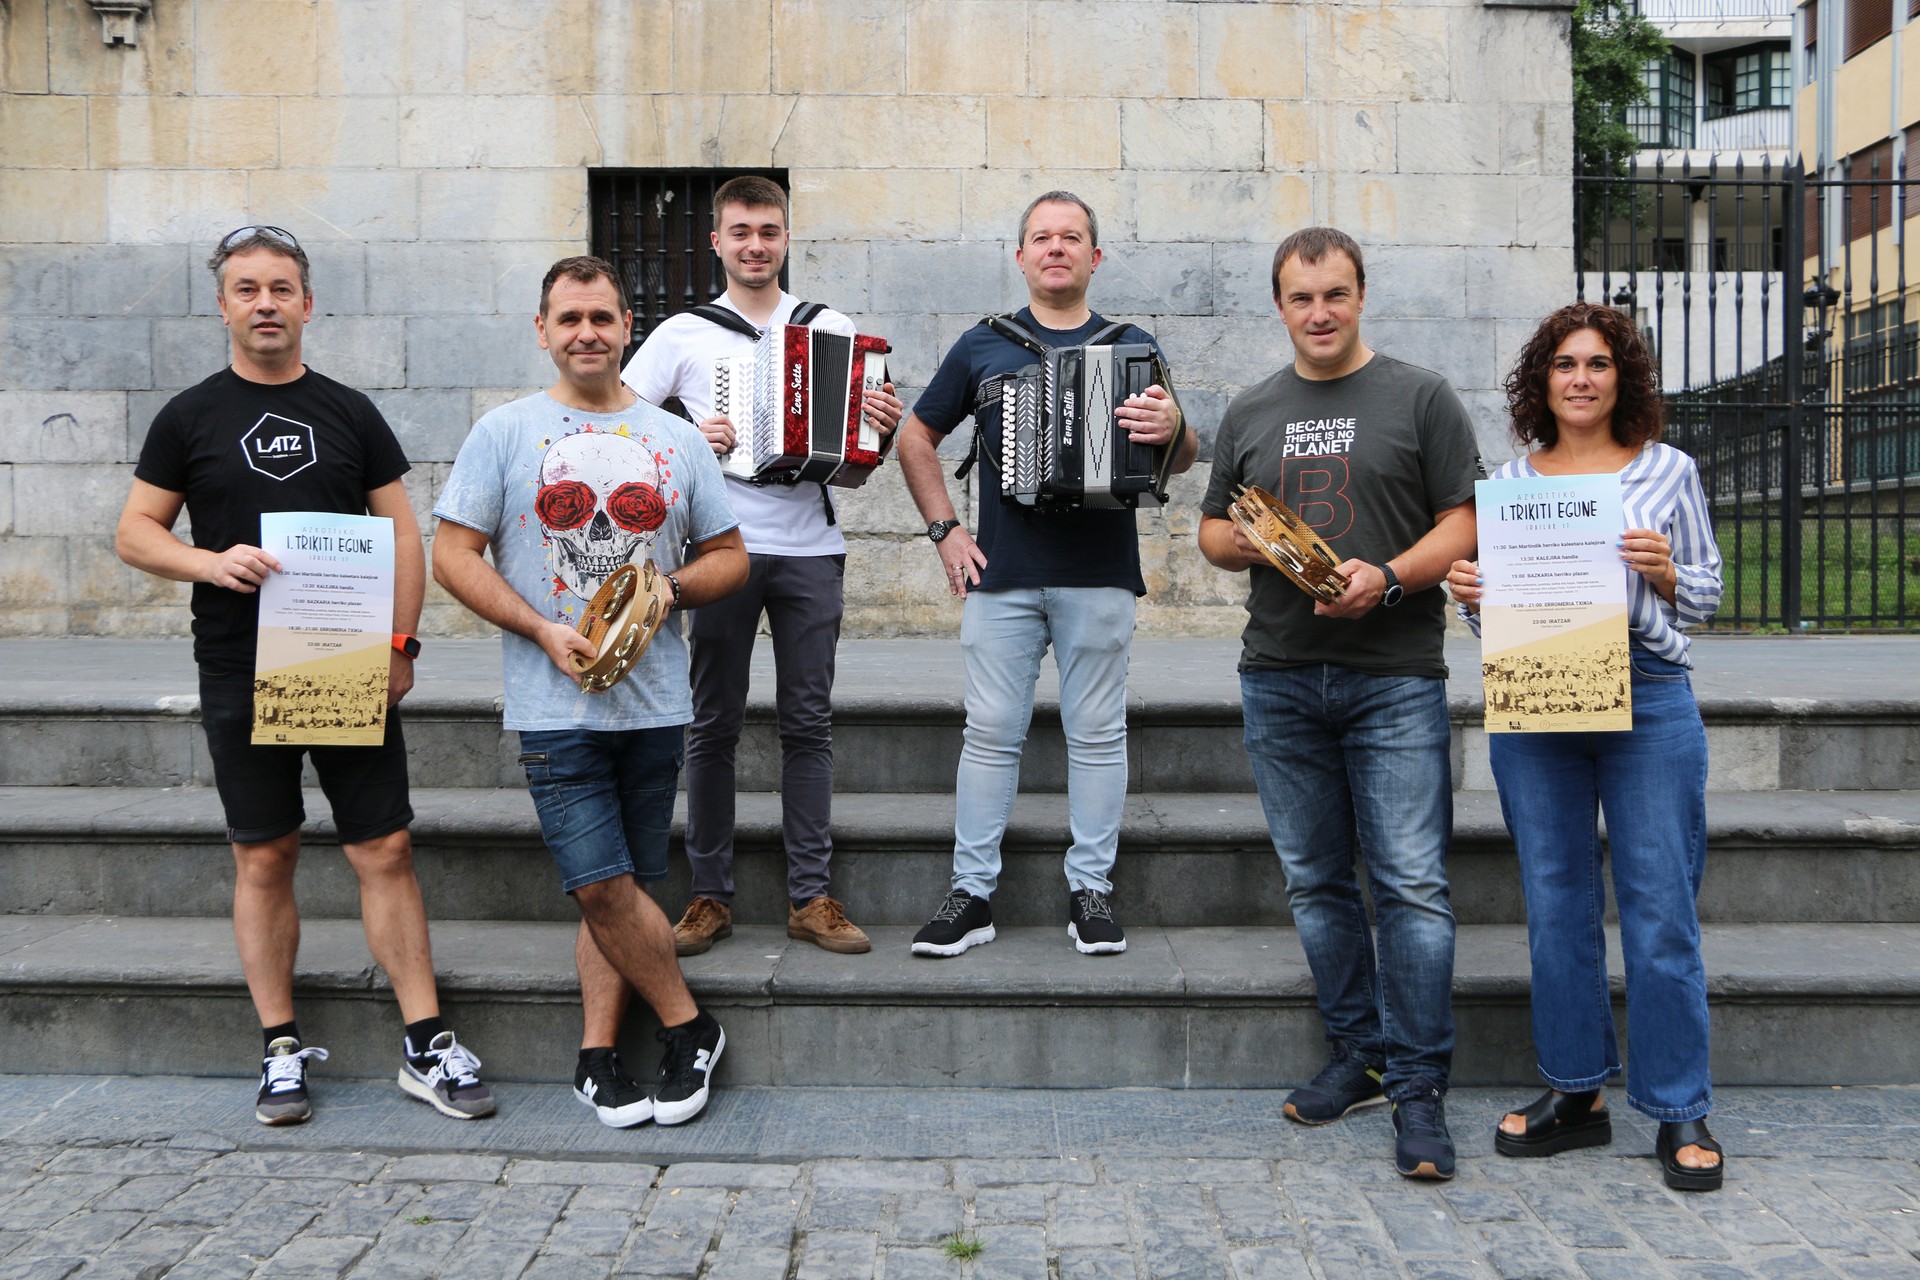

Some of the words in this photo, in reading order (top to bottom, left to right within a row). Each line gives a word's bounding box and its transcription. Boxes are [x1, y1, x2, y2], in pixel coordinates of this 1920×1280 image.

[791, 363, 802, 390] Sette
[791, 391, 802, 416] Zero
[1285, 418, 1356, 434] BECAUSE
[256, 435, 302, 453] LATZ
[1284, 432, 1322, 444] THERE
[1324, 430, 1334, 440] IS
[1337, 430, 1354, 439] NO
[1282, 439, 1354, 458] PLANET
[1282, 454, 1354, 540] B
[1517, 490, 1576, 501] AZKOTTIKO
[1558, 500, 1598, 518] EGUNE
[302, 527, 355, 535] AZKOTTIKO
[338, 538, 373, 554] EGUNE
